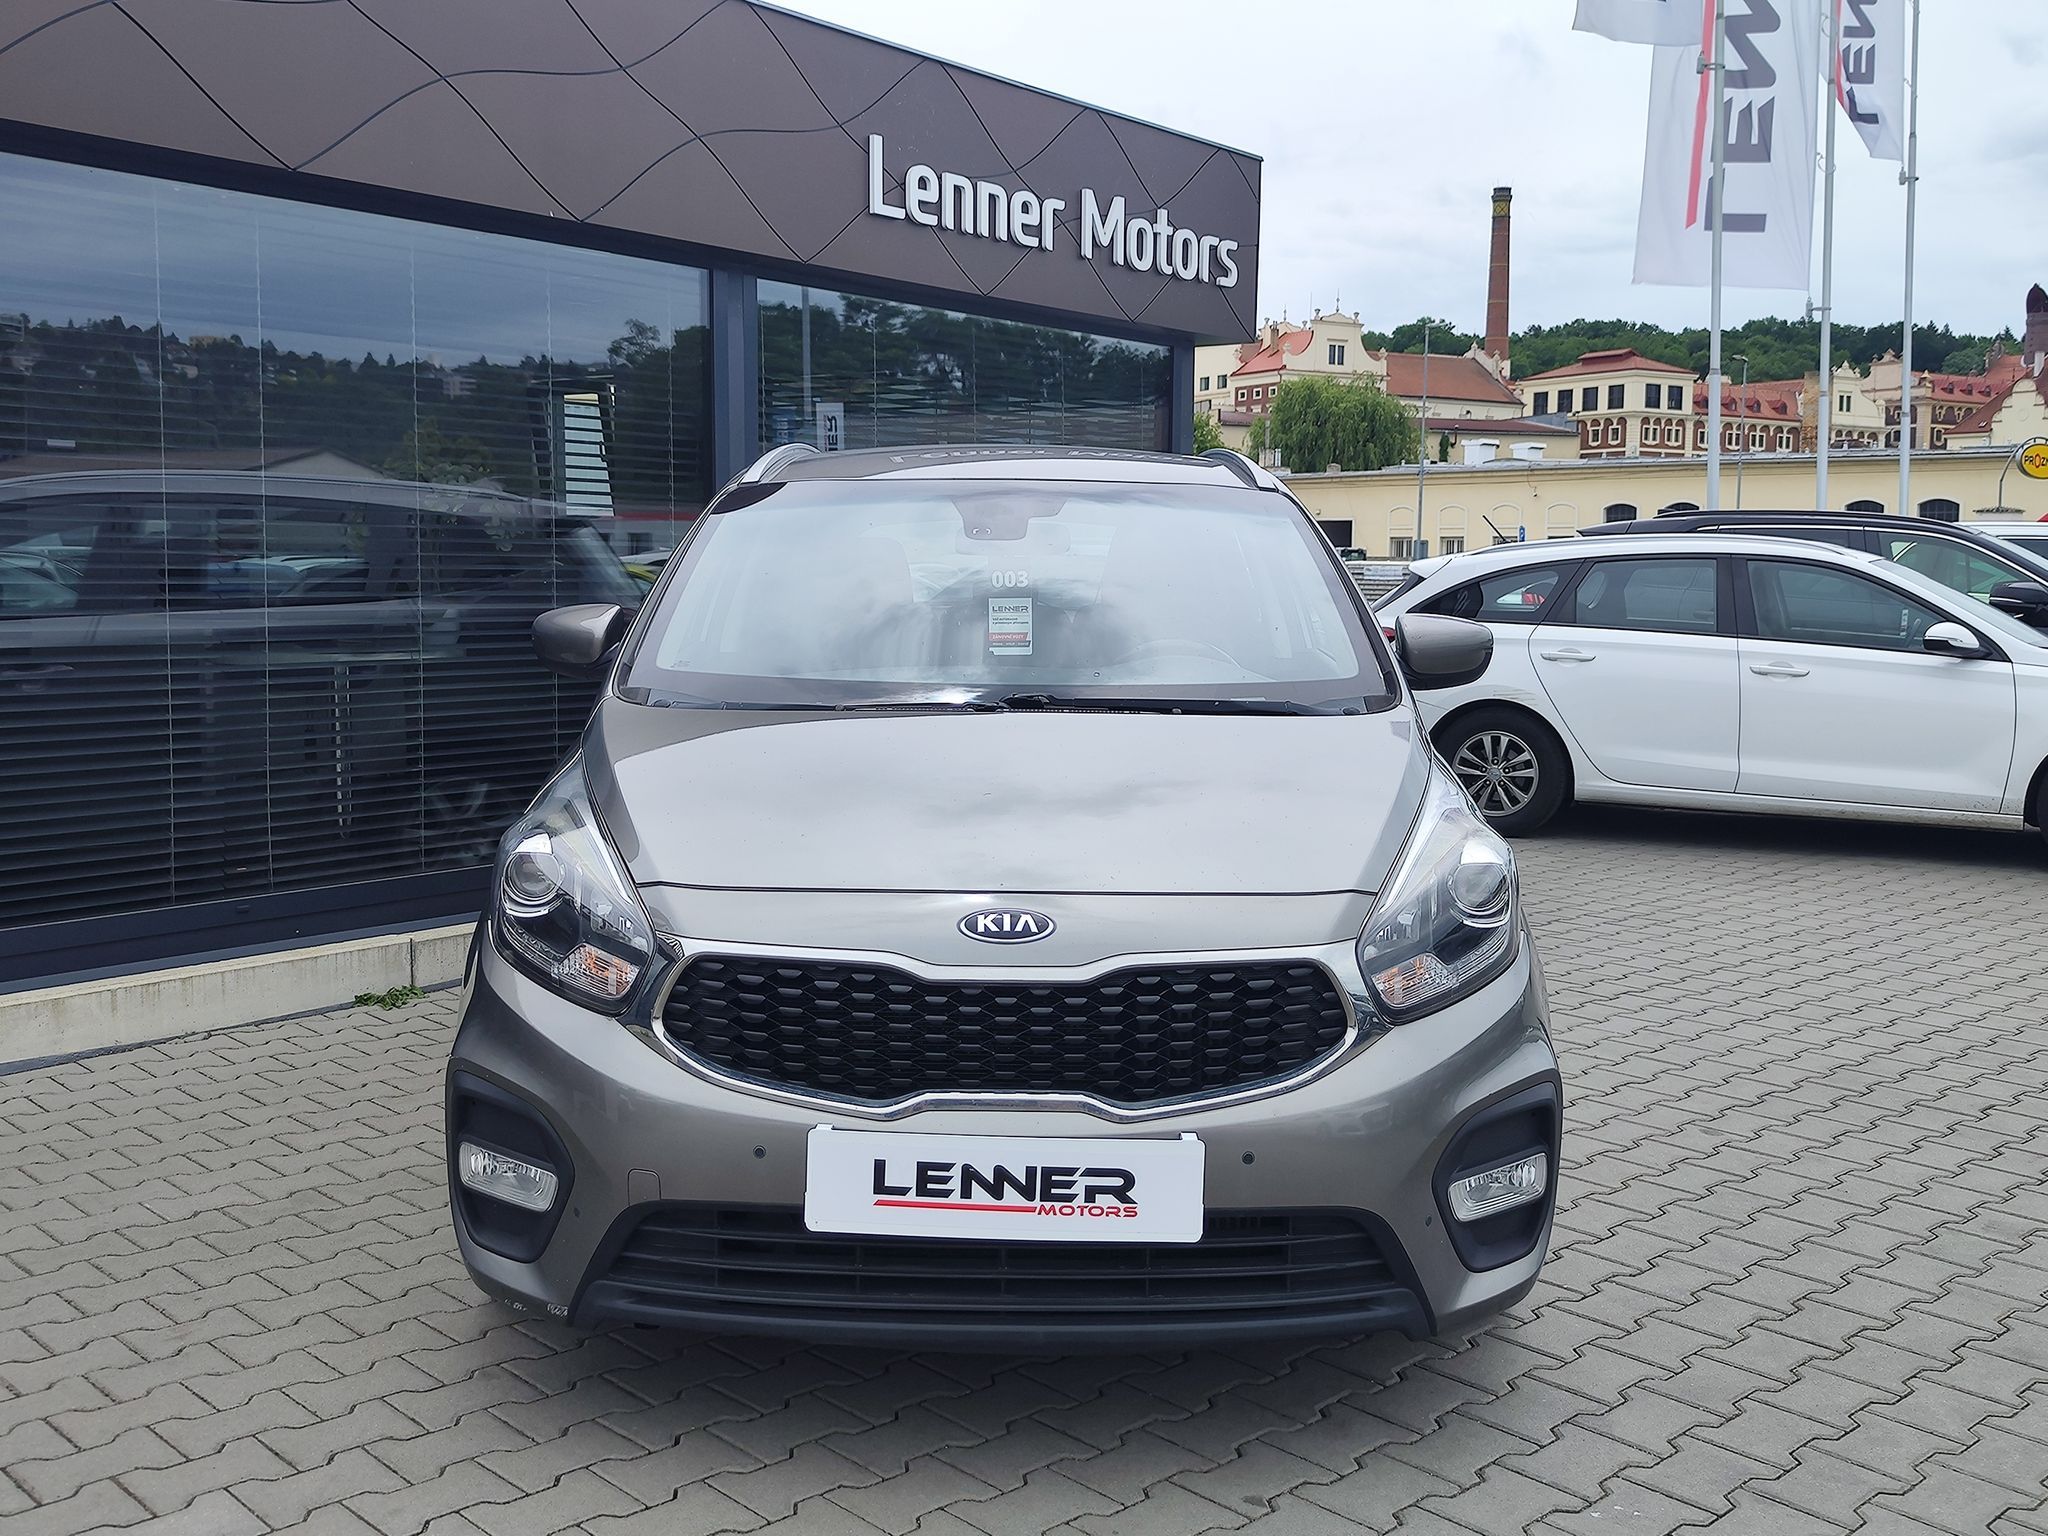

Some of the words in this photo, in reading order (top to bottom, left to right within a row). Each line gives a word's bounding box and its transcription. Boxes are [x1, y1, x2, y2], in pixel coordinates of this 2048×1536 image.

[868, 133, 1066, 253] Lenner
[1079, 187, 1239, 289] Motors
[991, 570, 1029, 588] 003
[992, 605, 1029, 613] LENNER
[975, 912, 1040, 934] KIA
[872, 1158, 1139, 1205] LENNER
[1037, 1203, 1139, 1218] MOTORS
